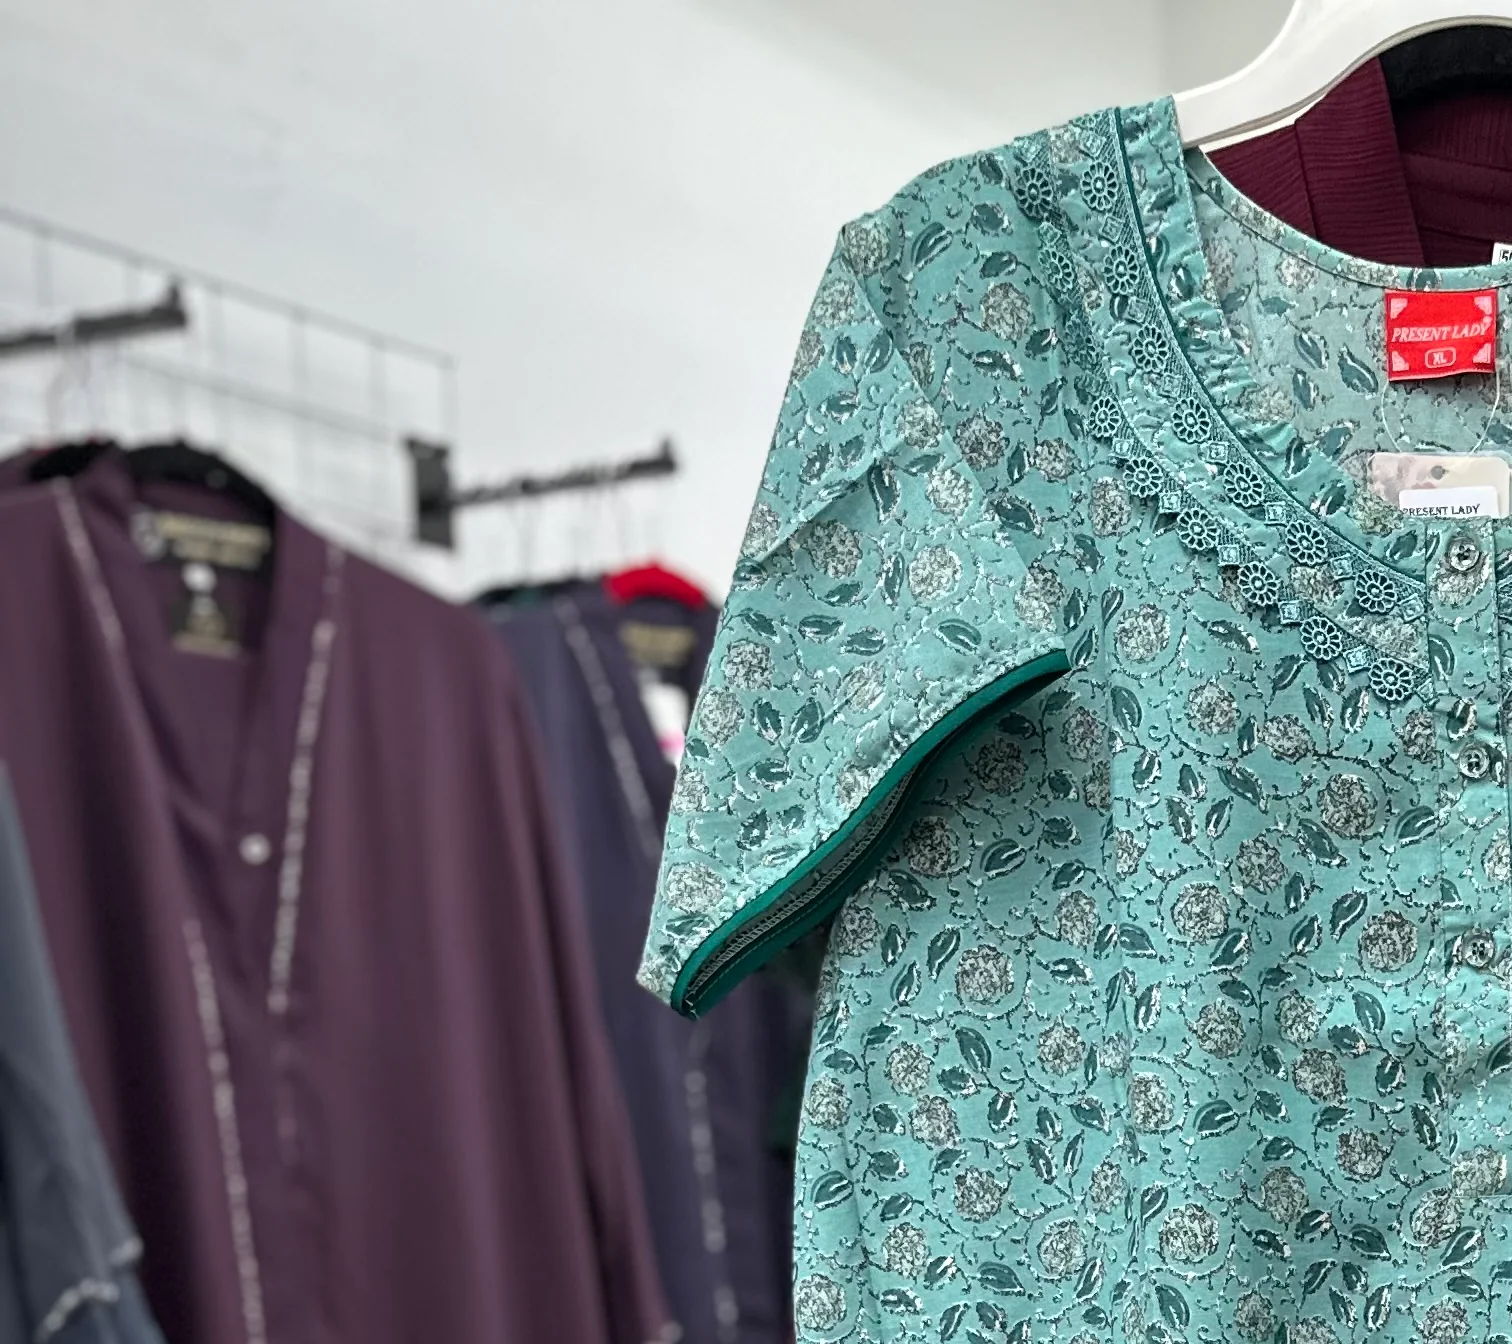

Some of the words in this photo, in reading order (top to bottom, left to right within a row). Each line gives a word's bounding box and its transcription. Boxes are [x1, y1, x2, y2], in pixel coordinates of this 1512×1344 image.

[1391, 326, 1451, 342] PRESENT
[1451, 322, 1491, 339] LADY
[1432, 351, 1448, 366] XL
[1451, 503, 1481, 515] LADY
